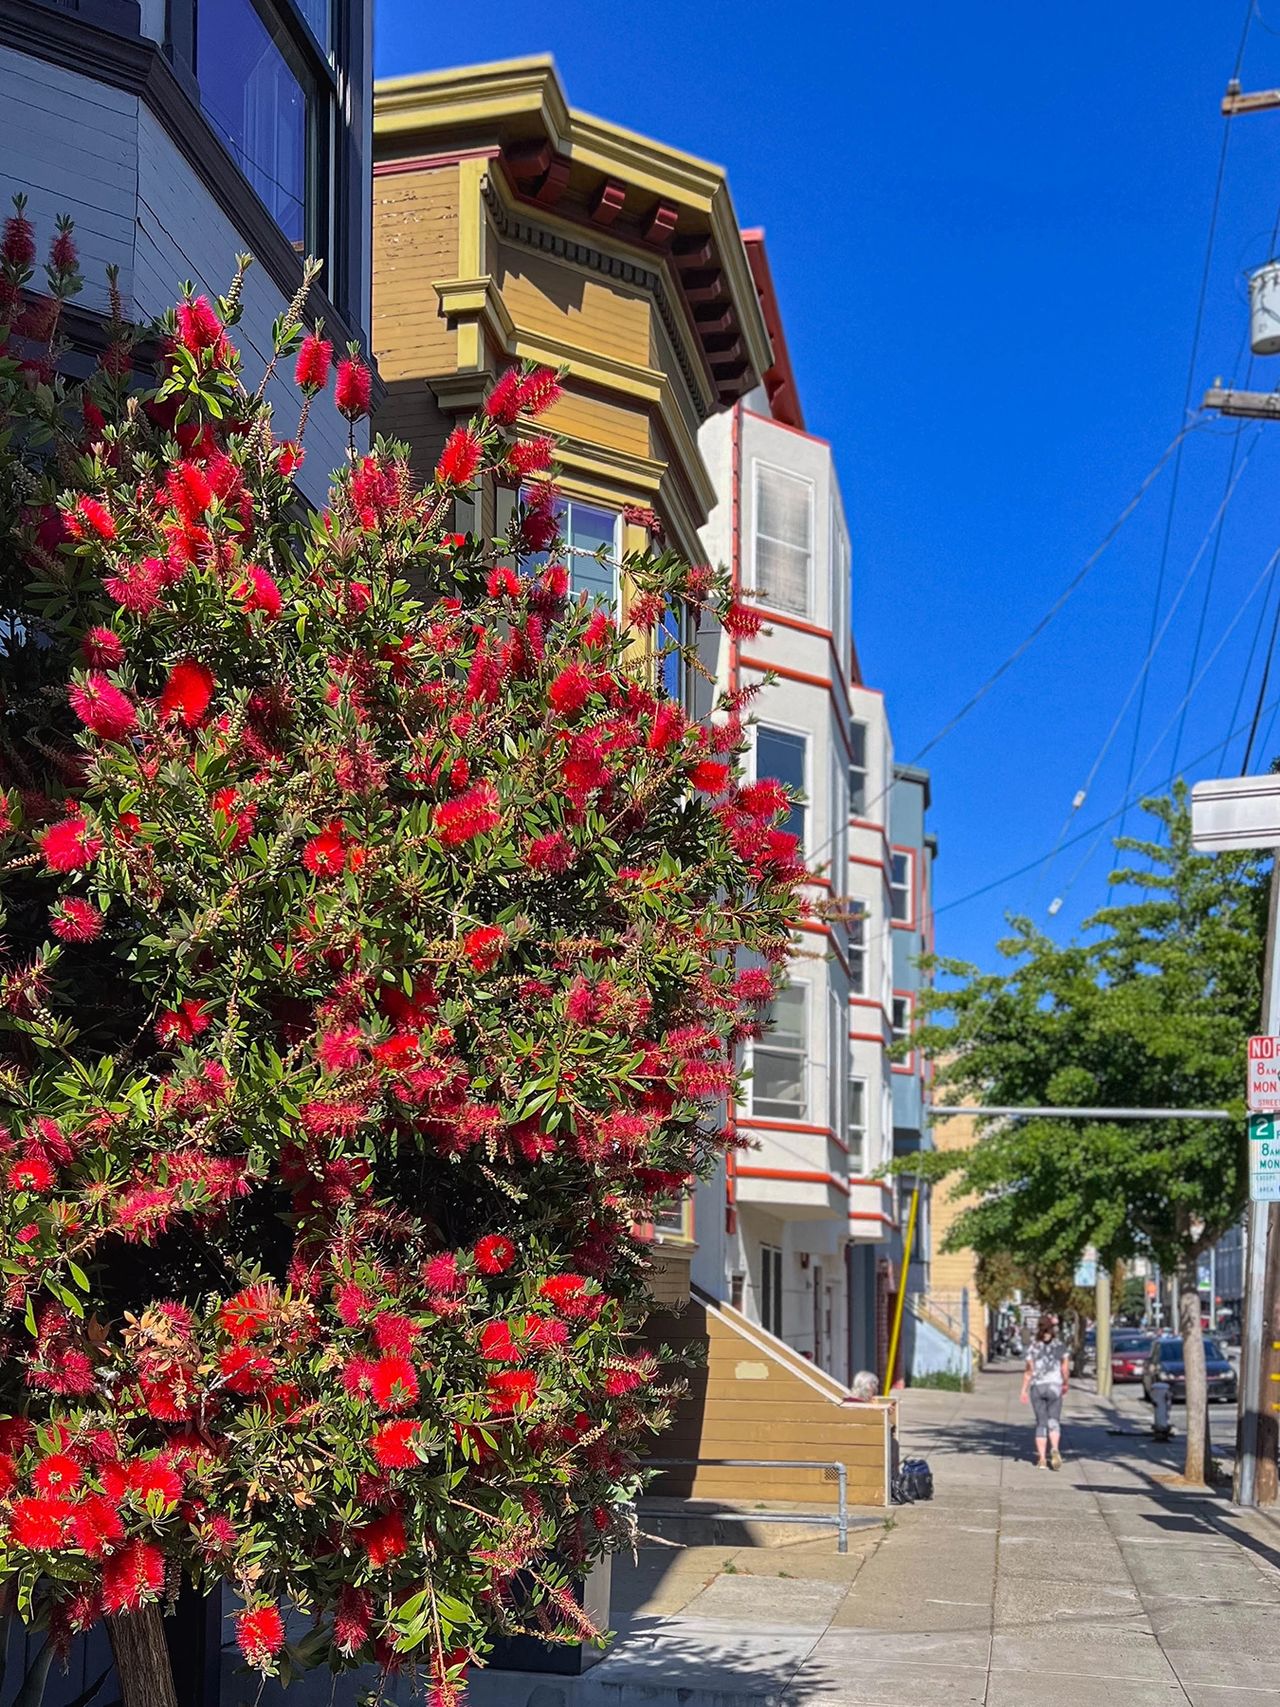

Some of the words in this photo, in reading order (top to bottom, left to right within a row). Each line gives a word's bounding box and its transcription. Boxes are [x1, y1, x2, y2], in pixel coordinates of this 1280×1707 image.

[1252, 1039, 1272, 1058] NO
[1253, 1081, 1277, 1093] MON
[1258, 1099, 1280, 1107] STREE
[1256, 1117, 1269, 1136] 2
[1260, 1160, 1280, 1169] MON
